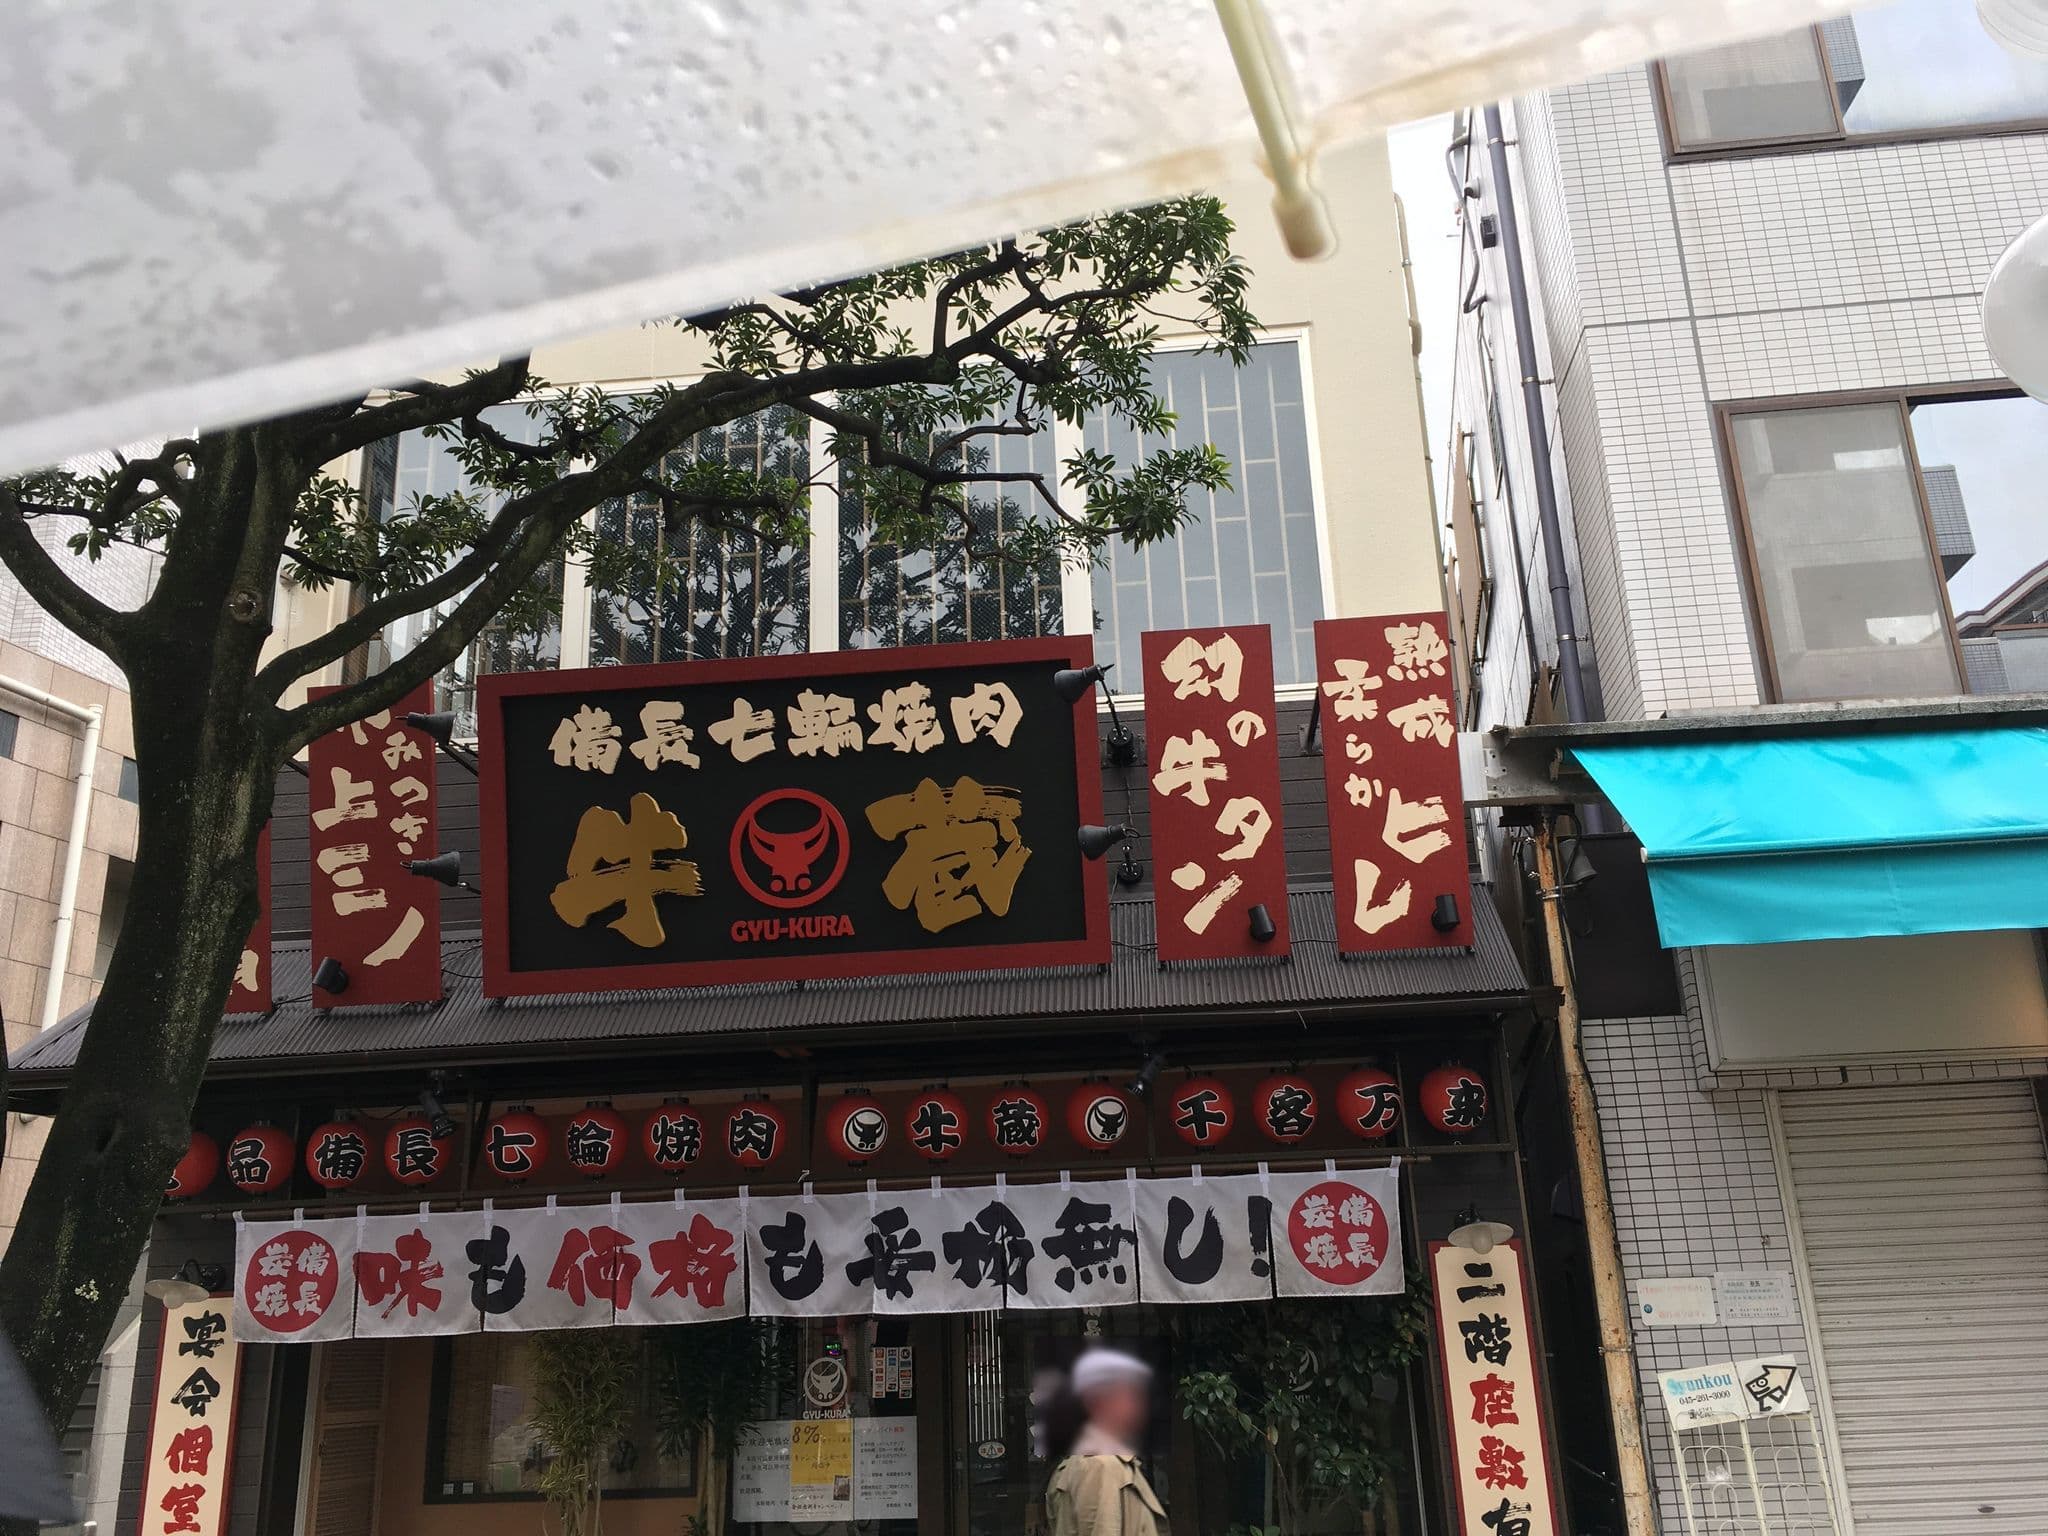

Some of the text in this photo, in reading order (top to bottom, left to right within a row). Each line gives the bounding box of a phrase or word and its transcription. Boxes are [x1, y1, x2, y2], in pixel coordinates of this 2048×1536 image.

[547, 680, 1024, 775] 備長七輪焼肉
[1152, 633, 1272, 935] 幻の牛タン
[312, 767, 425, 967] 上ミノ
[731, 914, 855, 942] GYU-KURA
[911, 1098, 1042, 1153] 牛蔵
[160, 1310, 228, 1535] 宴会個室
[803, 1409, 850, 1420] GYU-KURA
